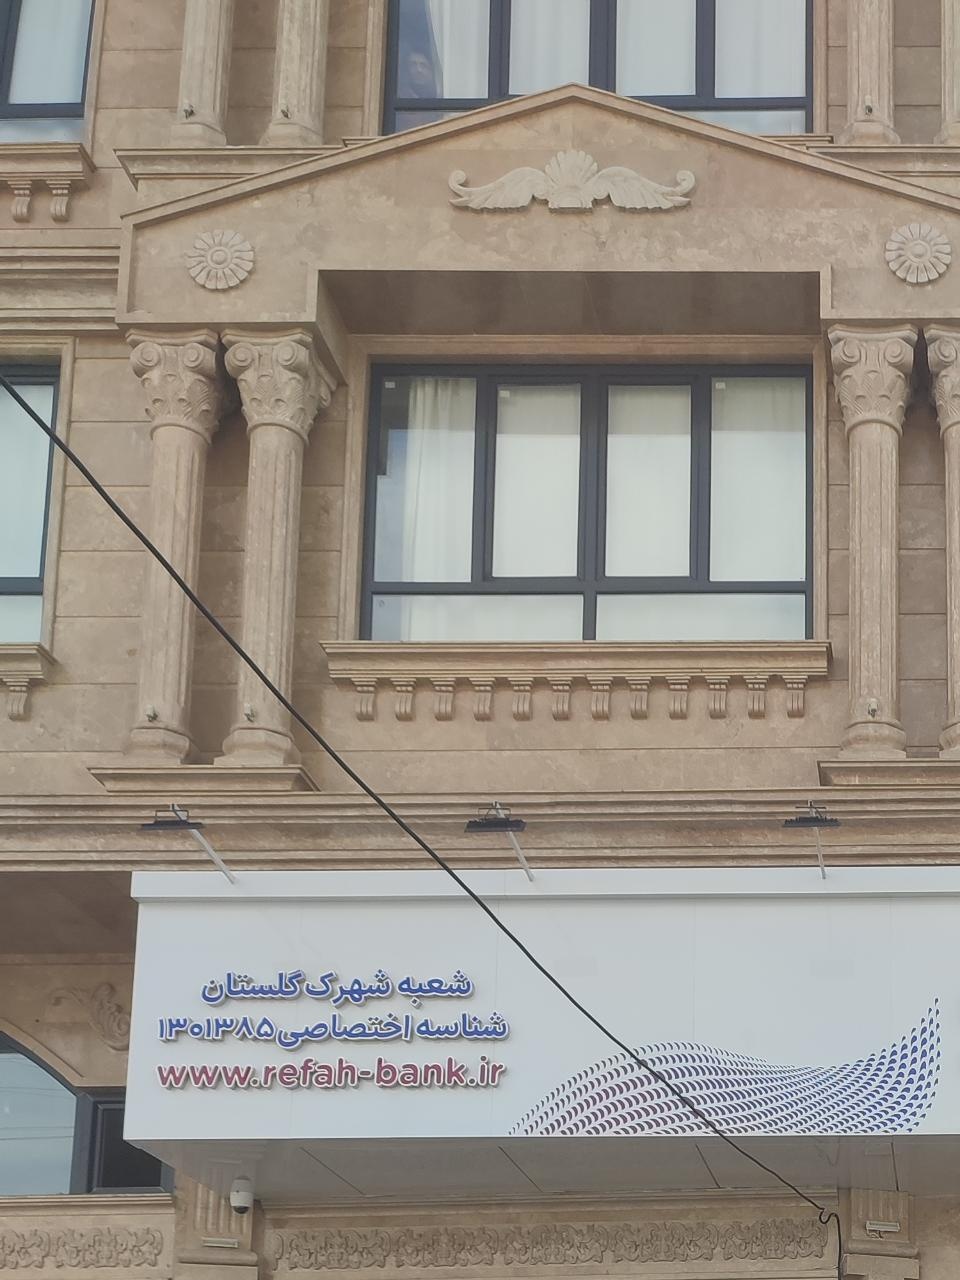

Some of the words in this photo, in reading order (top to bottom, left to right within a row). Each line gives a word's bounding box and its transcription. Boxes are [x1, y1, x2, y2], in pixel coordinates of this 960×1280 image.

[201, 969, 304, 1004] گلستان
[304, 969, 392, 1006] شهرک
[397, 968, 474, 1008] شعبه
[157, 1014, 275, 1041] ۱۳۰۱۳۸۵
[276, 1011, 412, 1049] اختصاصی
[415, 1011, 509, 1040] شناسه
[156, 1055, 505, 1089] www.refah-bank.ir
